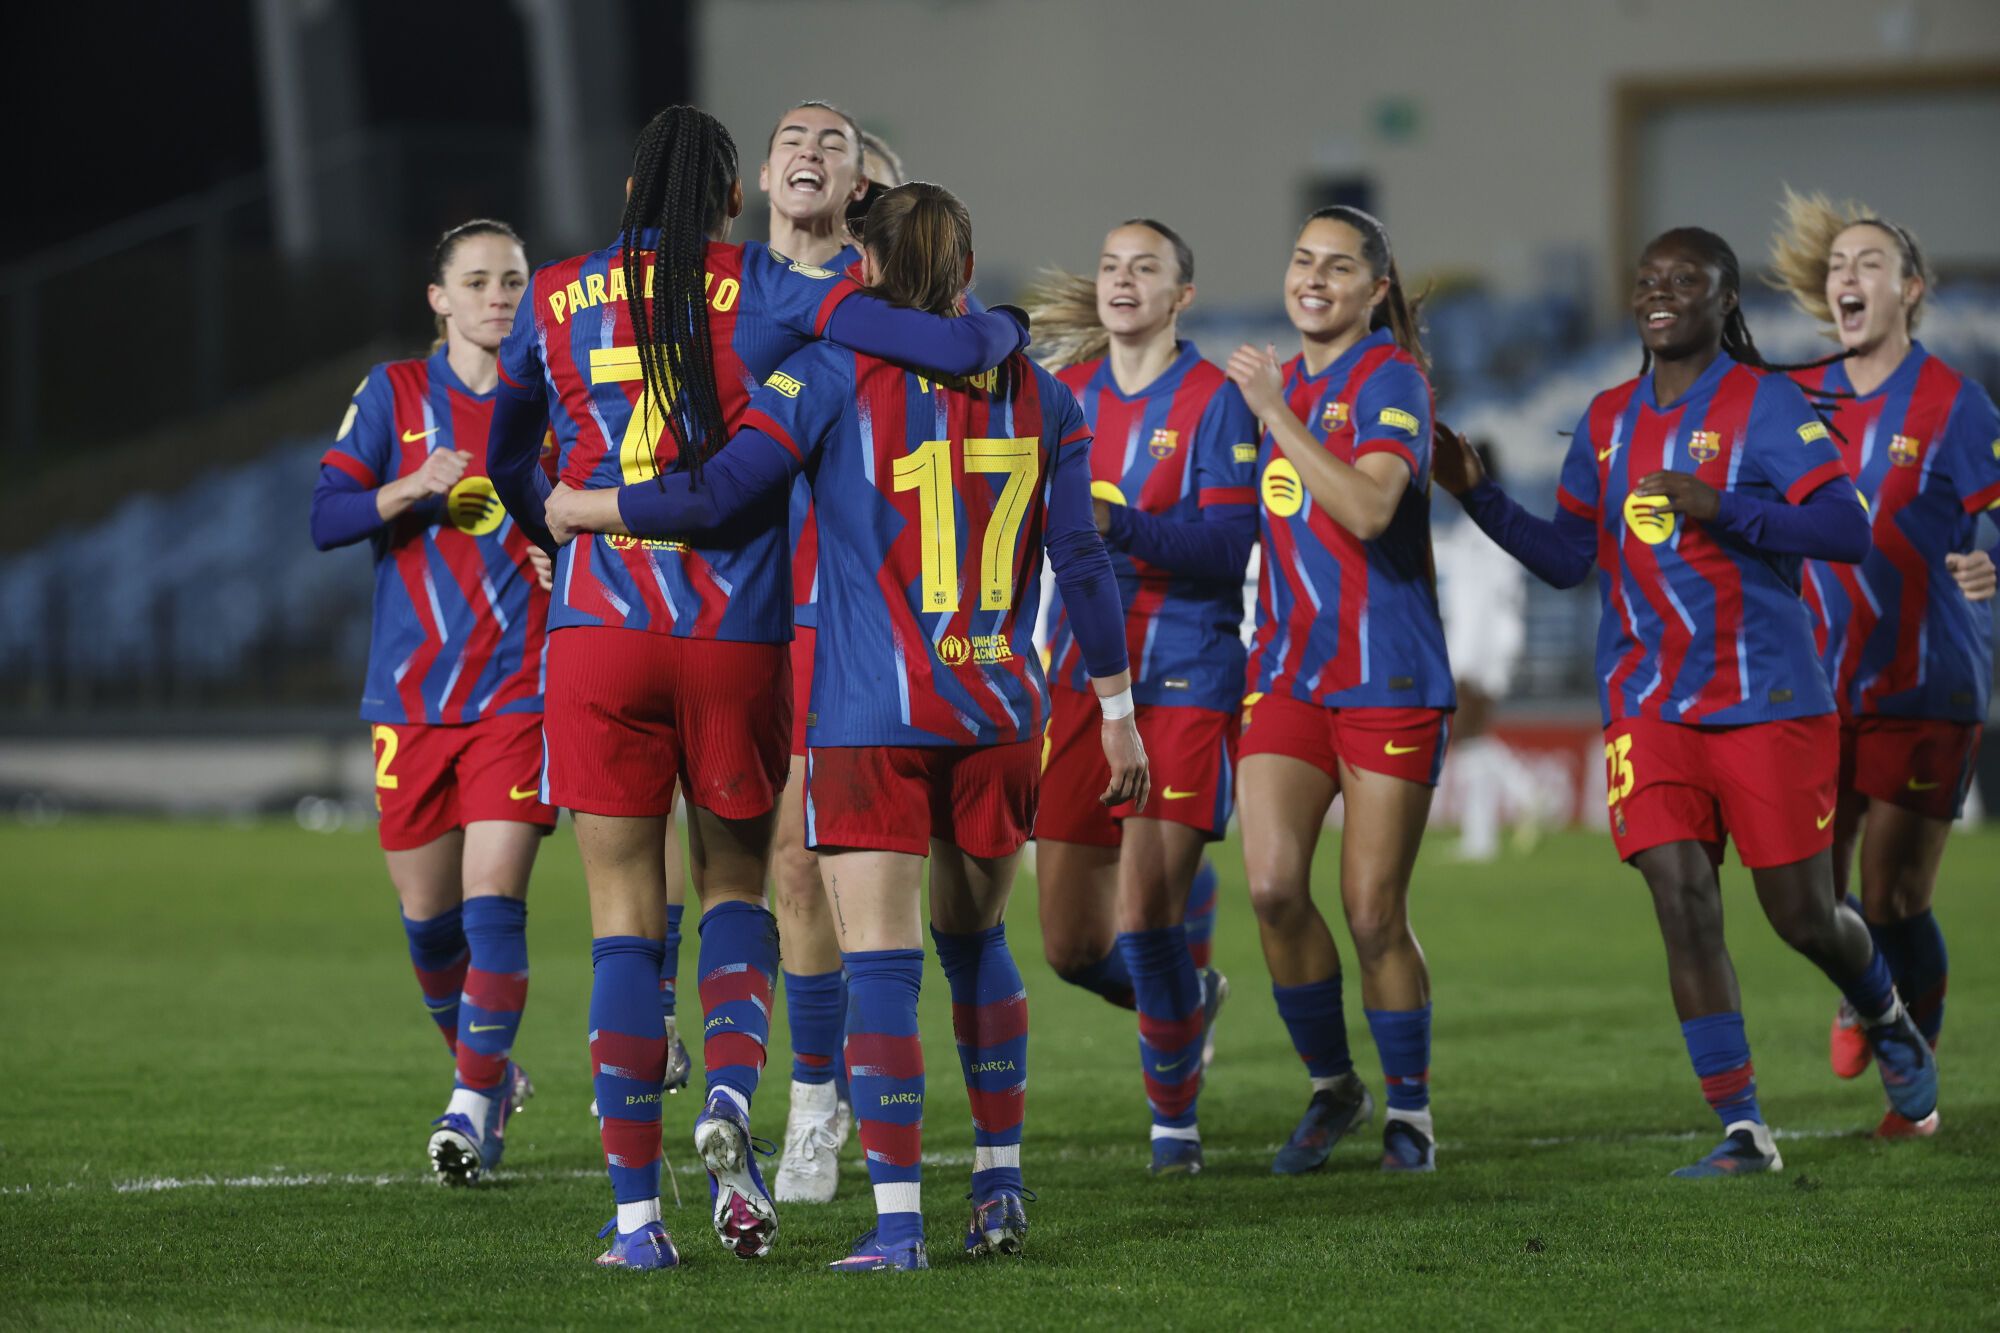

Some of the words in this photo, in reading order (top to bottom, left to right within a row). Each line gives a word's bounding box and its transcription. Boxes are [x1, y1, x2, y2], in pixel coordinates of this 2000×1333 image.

[549, 264, 740, 325] PARALO
[766, 374, 801, 395] MBO
[590, 343, 681, 486] 7
[893, 437, 1039, 613] 17
[972, 635, 1007, 647] UNHCR
[973, 646, 1012, 659] ACNUR
[372, 724, 399, 789] 2
[1606, 733, 1634, 806] 23
[971, 1060, 1015, 1074] BARÇA
[625, 1094, 660, 1106] BARÇ
